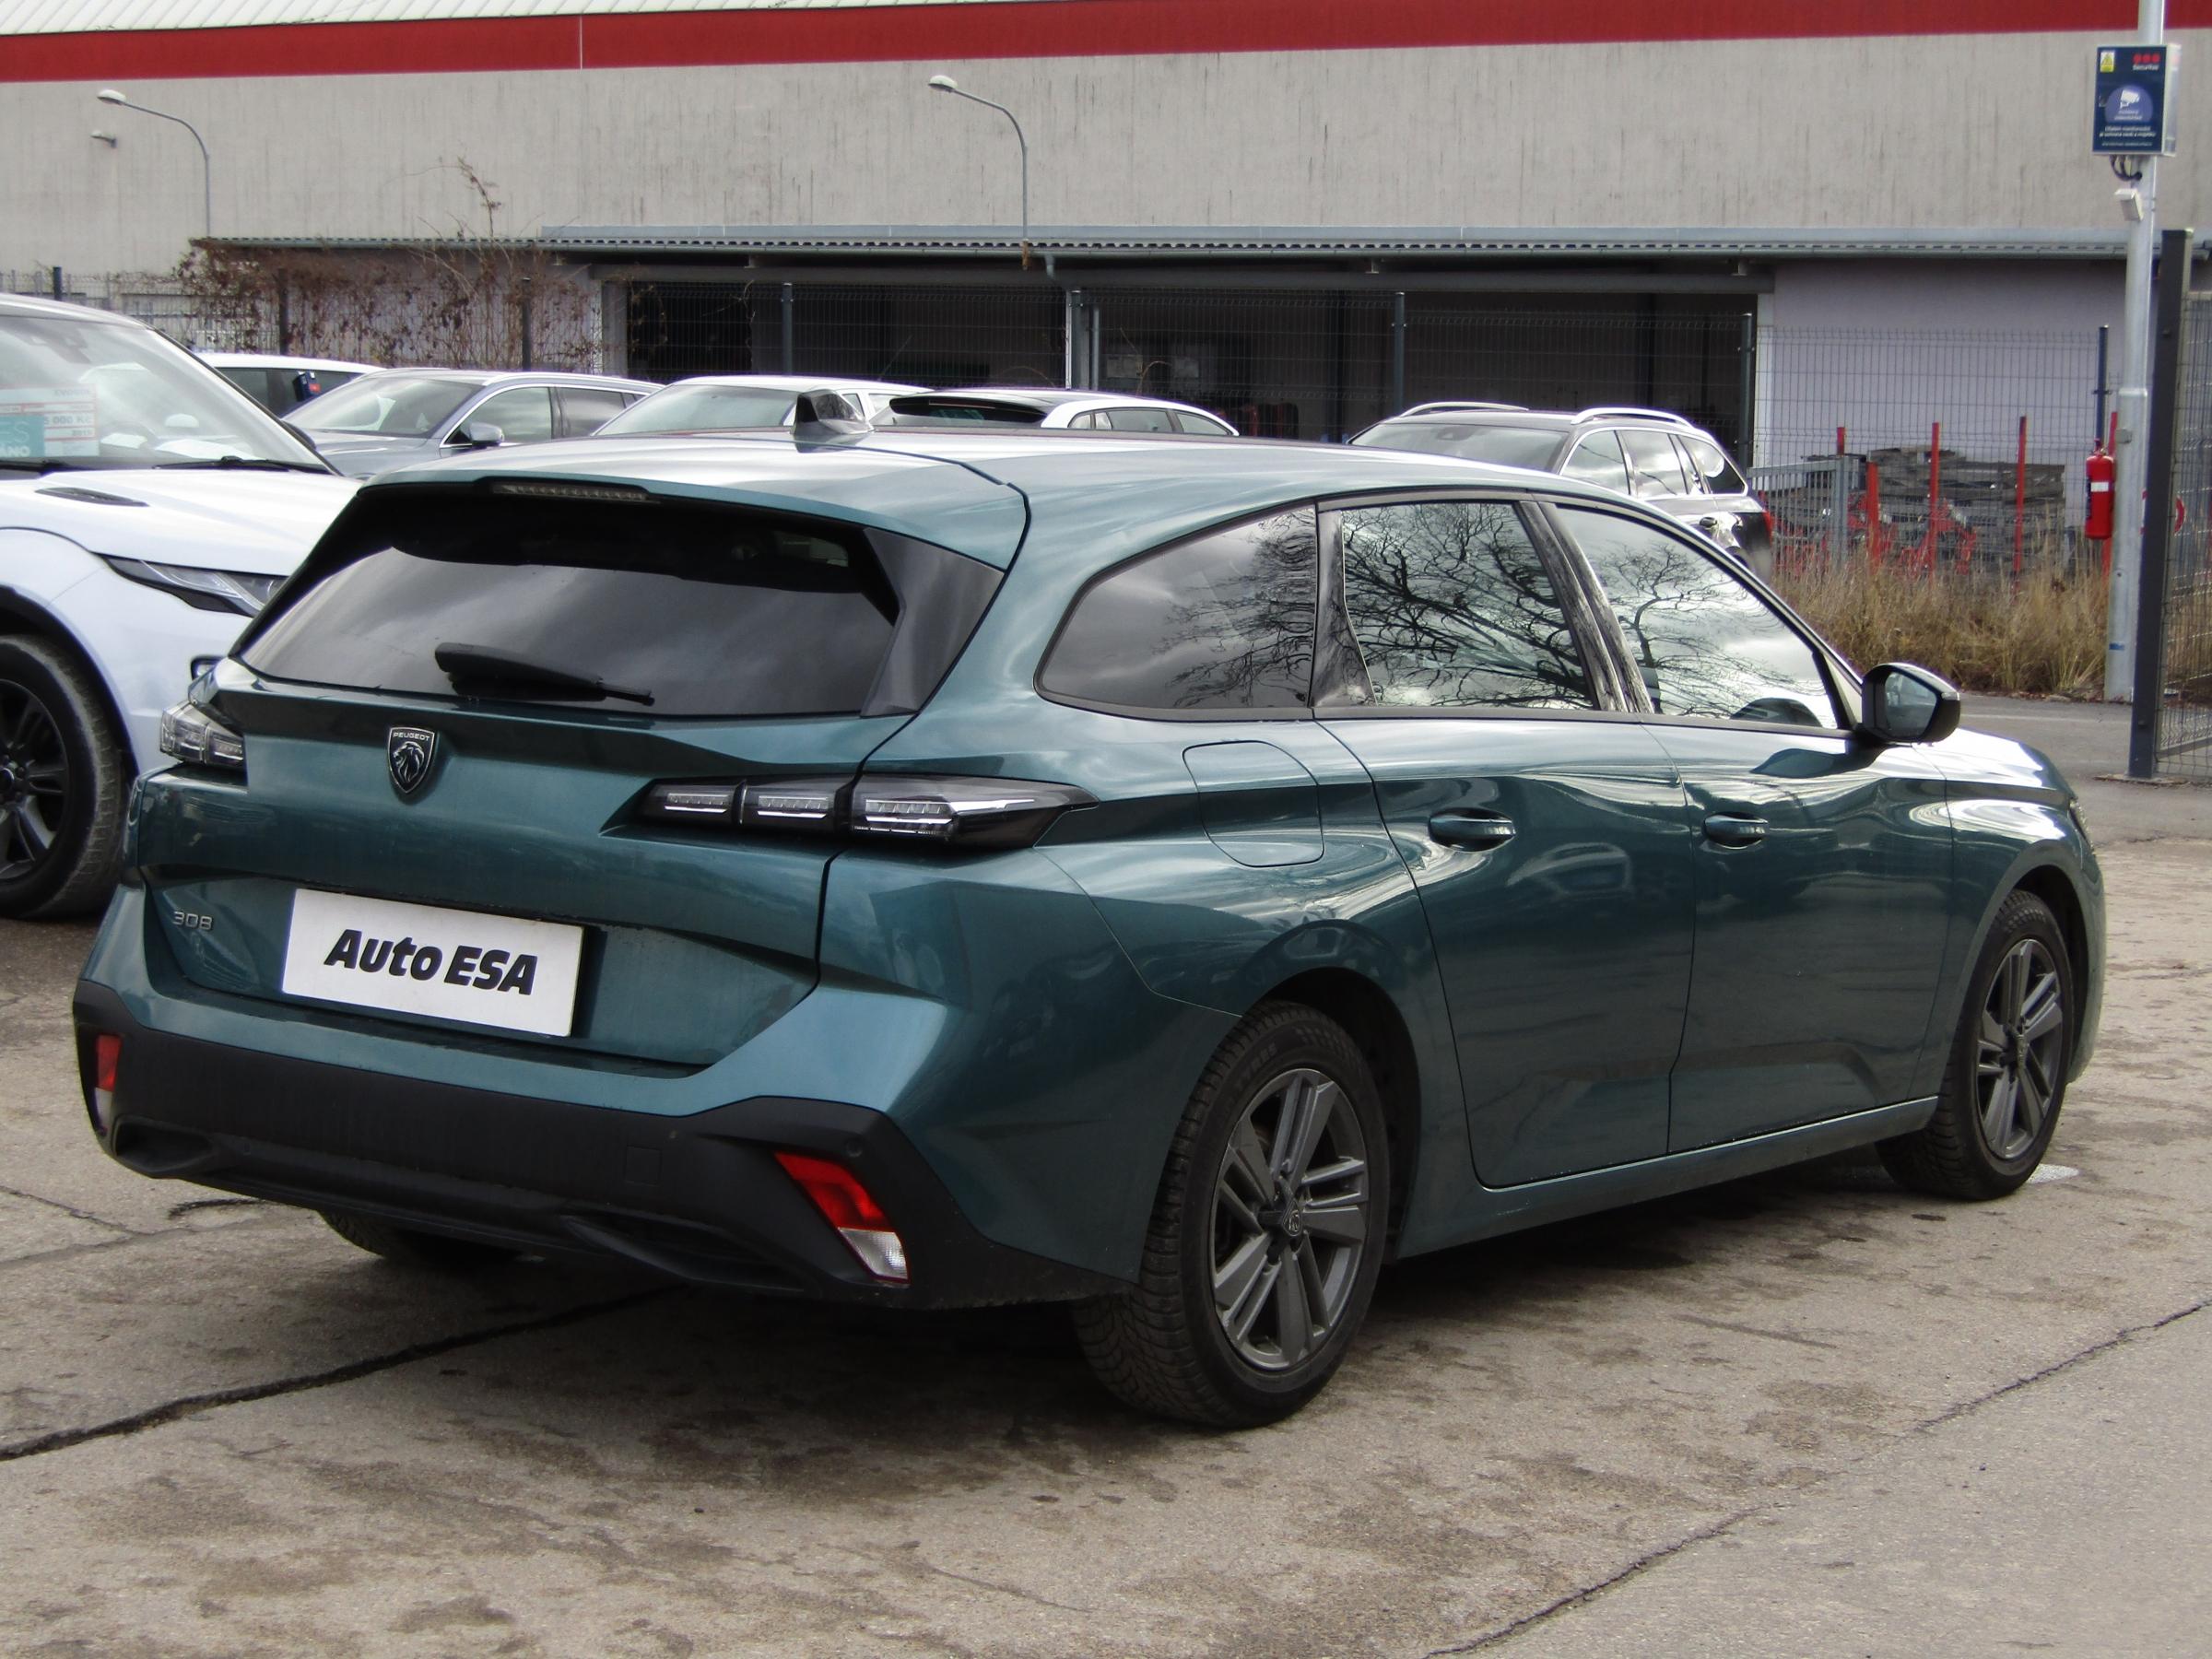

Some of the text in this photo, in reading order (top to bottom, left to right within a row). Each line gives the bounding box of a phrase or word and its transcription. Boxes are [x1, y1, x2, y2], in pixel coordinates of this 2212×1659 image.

[393, 732, 430, 741] PEUGEOT
[172, 911, 213, 930] 308
[324, 928, 538, 995] Auto ESA
